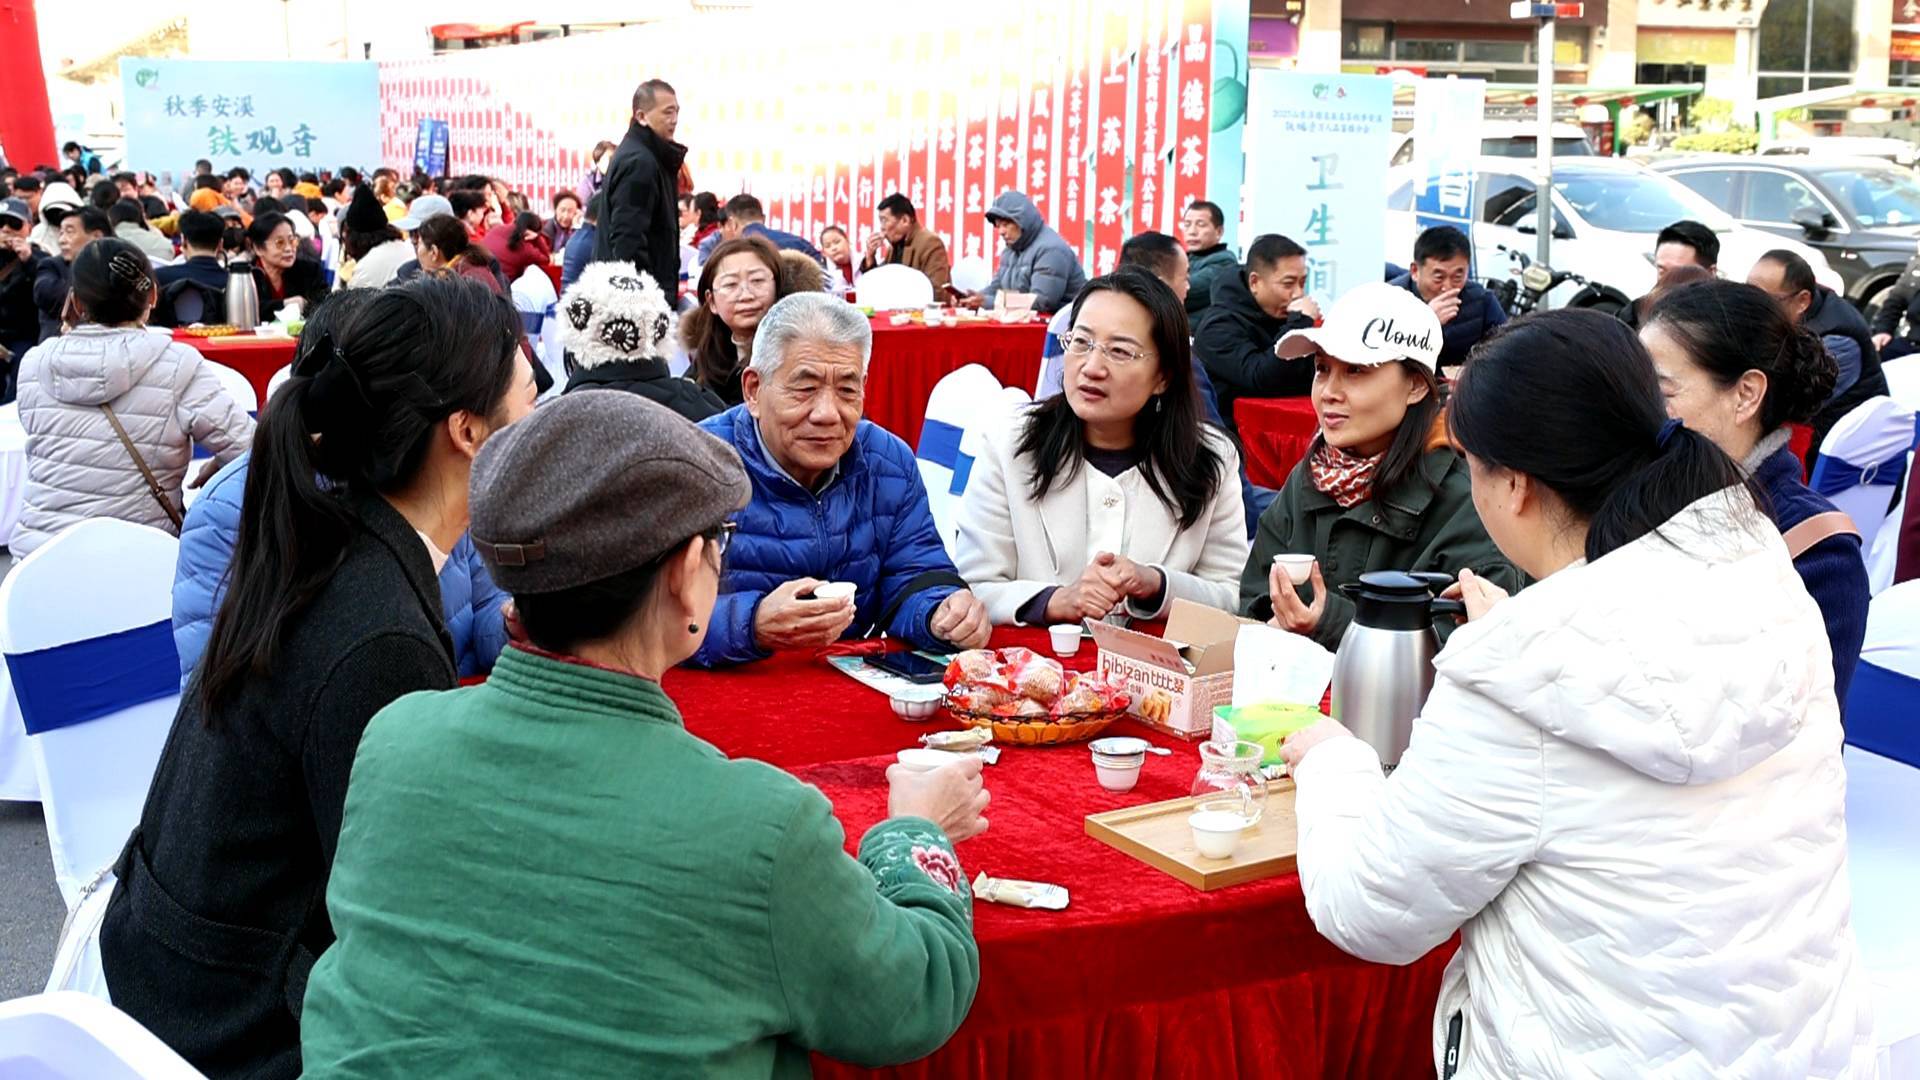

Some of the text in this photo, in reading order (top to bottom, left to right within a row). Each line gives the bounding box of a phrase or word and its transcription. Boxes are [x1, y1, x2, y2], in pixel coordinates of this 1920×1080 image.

[164, 95, 255, 118] 秋季安溪
[207, 123, 318, 158] 铁观音
[1304, 152, 1344, 300] 卫生间
